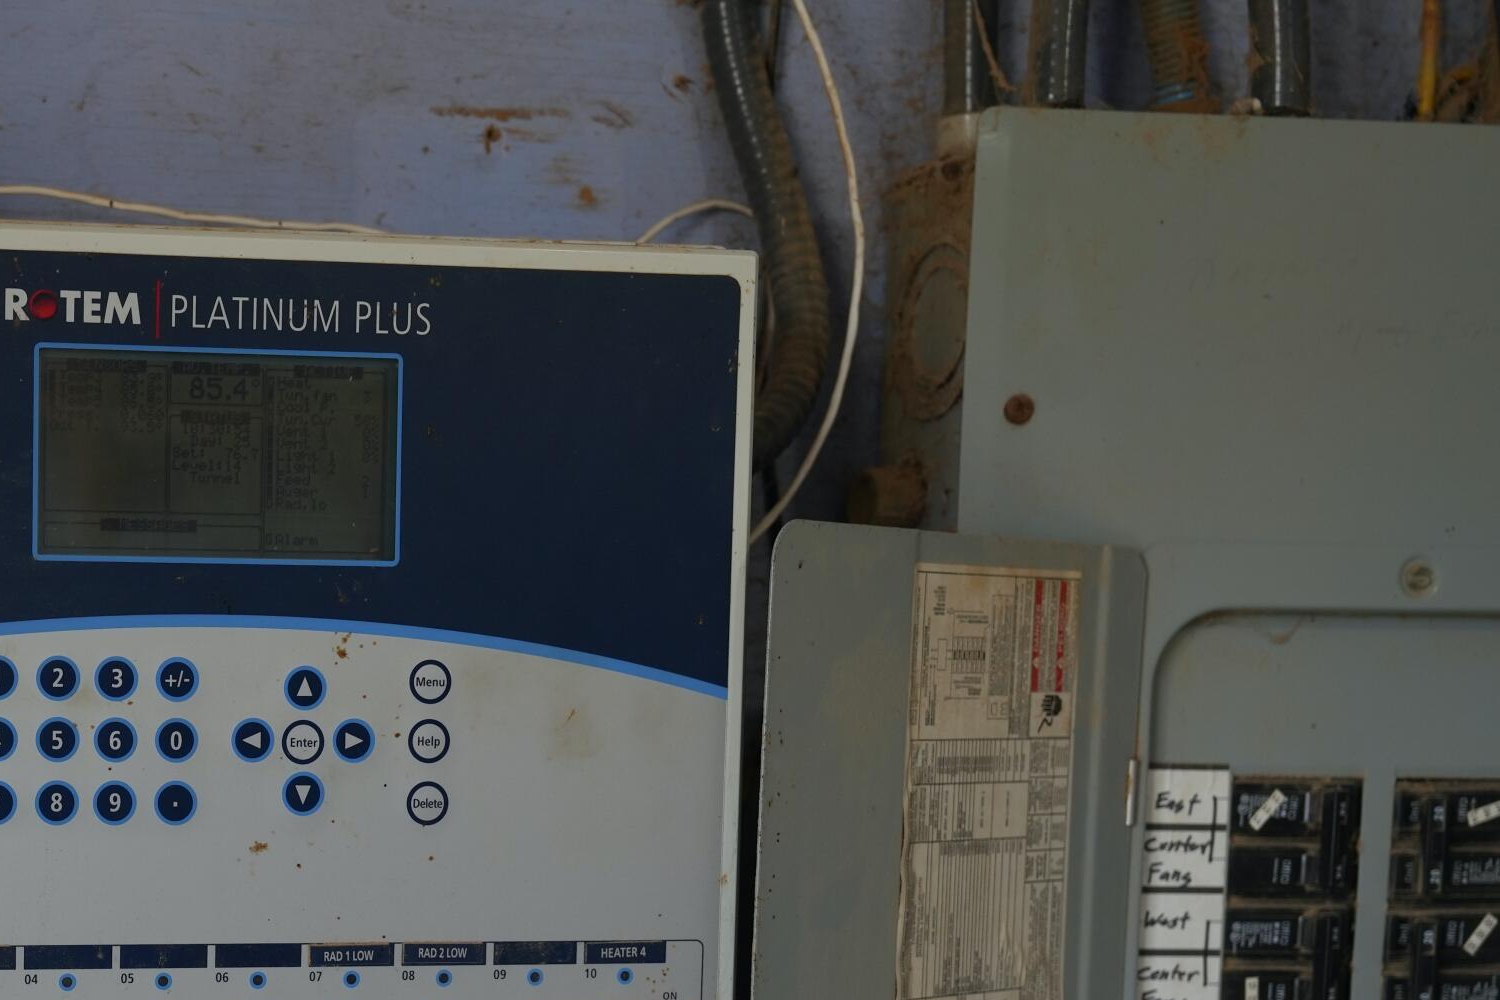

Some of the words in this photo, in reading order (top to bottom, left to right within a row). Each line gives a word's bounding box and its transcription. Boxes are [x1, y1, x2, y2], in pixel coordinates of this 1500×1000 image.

[4, 287, 141, 326] ROTEM
[171, 293, 340, 334] PLATINUM
[356, 300, 432, 336] PLUS
[52, 668, 64, 688] 2
[111, 668, 123, 688] 3
[164, 670, 190, 689] +/-
[415, 676, 445, 688] Menu
[51, 730, 63, 750] 5
[108, 730, 121, 750] 6
[170, 731, 182, 751] 0
[289, 737, 318, 749] Enter
[416, 735, 441, 749] Help
[50, 793, 63, 813] 8
[108, 793, 121, 813] 9
[412, 798, 443, 809] Delete
[323, 949, 343, 962] RAD
[345, 949, 351, 961] 1
[352, 949, 374, 962] LOW
[417, 947, 437, 959] RAD
[438, 947, 445, 959] 2
[446, 946, 468, 959] LOW
[600, 946, 639, 959] HEATER
[639, 946, 647, 958] 4
[120, 972, 134, 985] 05
[215, 971, 229, 984] 06
[309, 970, 323, 983] 07
[401, 969, 415, 982] 08
[493, 968, 507, 981] 09
[584, 966, 597, 979] 10
[24, 973, 38, 986] 04
